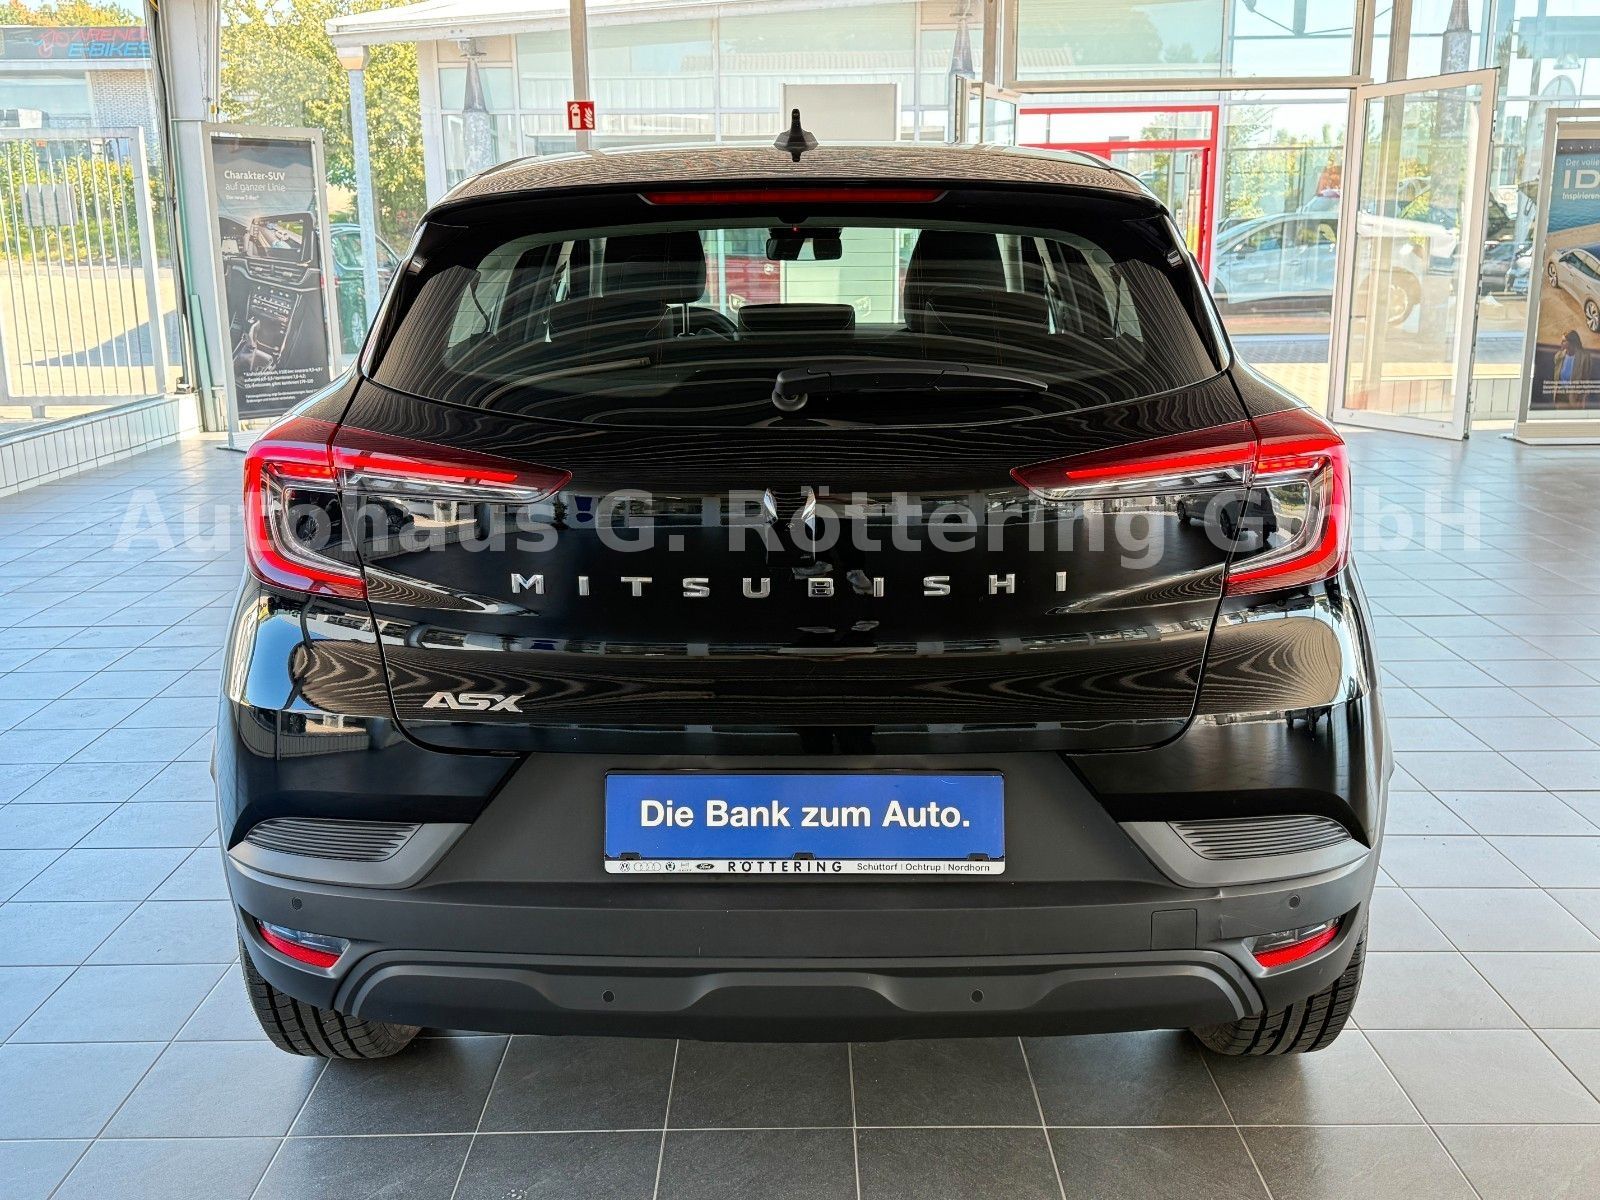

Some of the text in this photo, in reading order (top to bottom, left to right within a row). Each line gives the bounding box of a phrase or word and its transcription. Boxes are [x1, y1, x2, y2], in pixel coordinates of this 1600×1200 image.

[224, 170, 286, 181] Charakter-SUV
[225, 181, 286, 193] auf ganzer Linie
[510, 571, 1067, 599] MITSUBISHI
[422, 691, 526, 713] ASX
[640, 800, 971, 828] Die Bank zum Auto.
[727, 861, 842, 873] RÖTTERING
[904, 863, 941, 873] Ochtrup
[947, 863, 990, 872] Nordhorn
